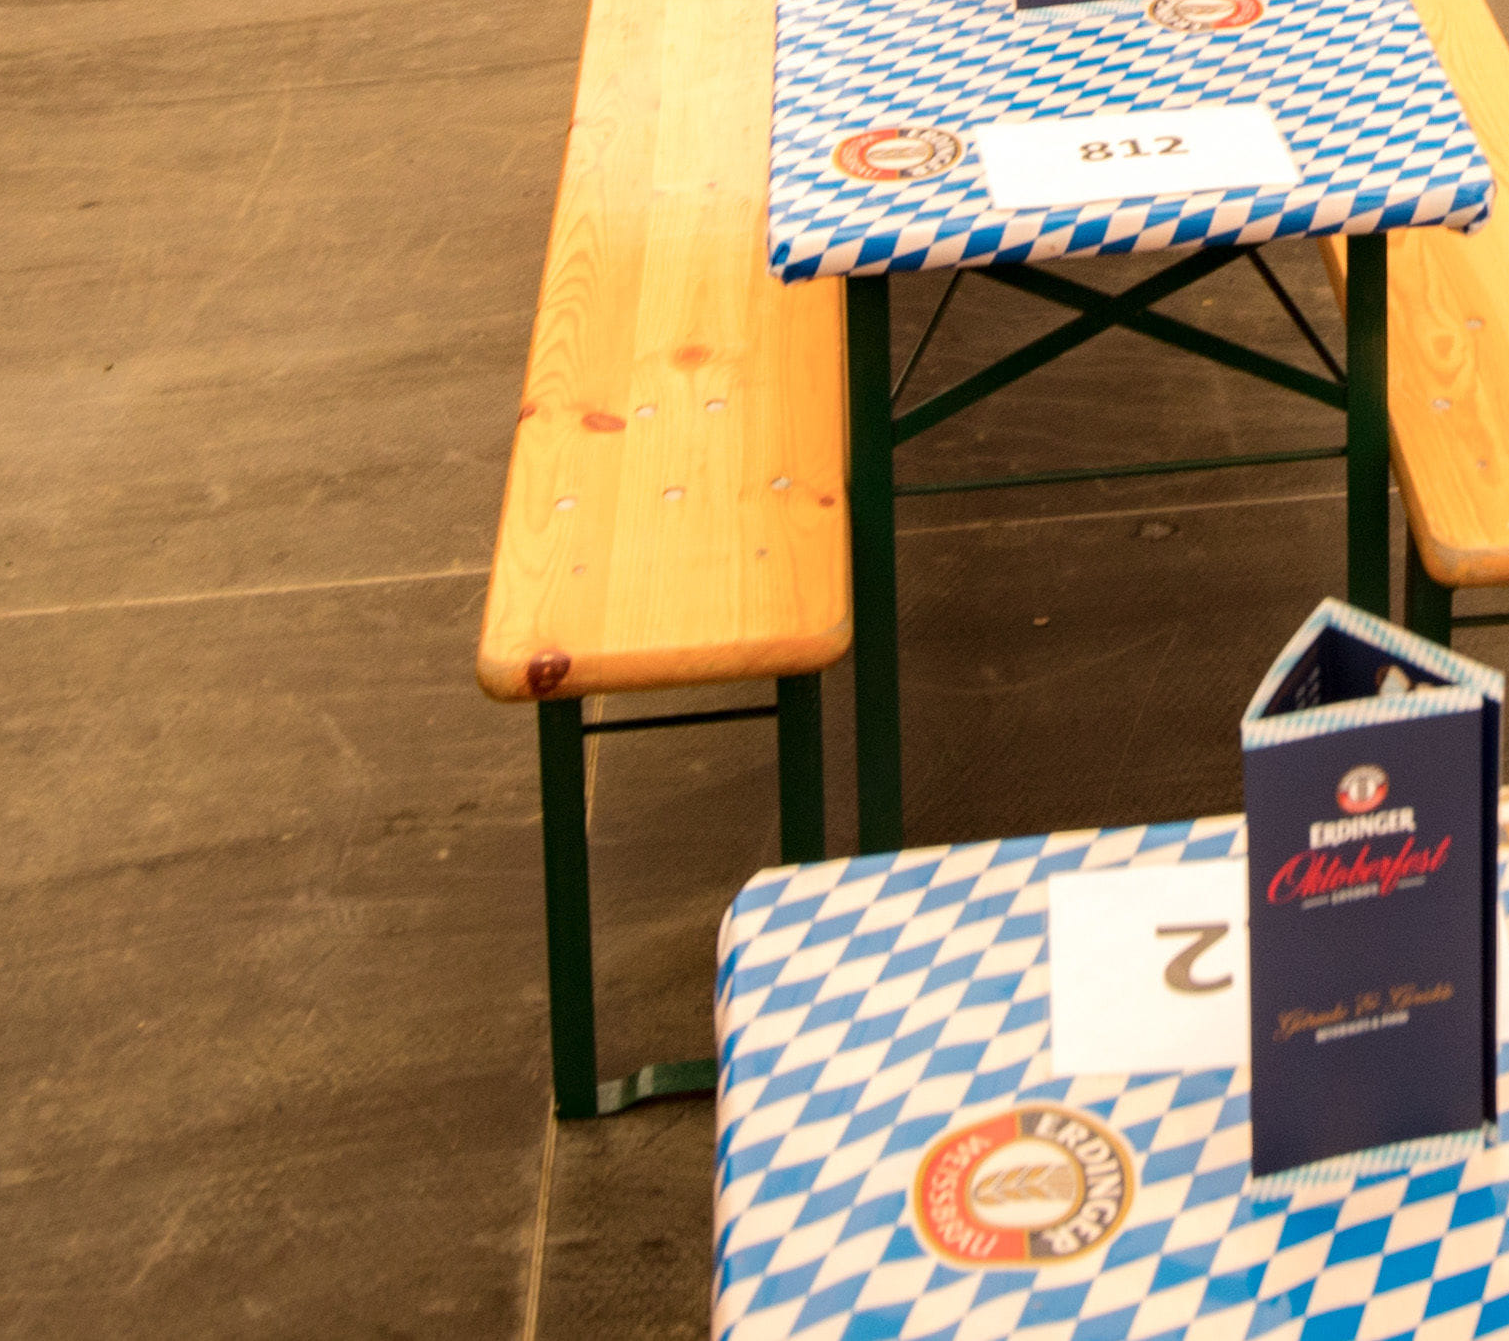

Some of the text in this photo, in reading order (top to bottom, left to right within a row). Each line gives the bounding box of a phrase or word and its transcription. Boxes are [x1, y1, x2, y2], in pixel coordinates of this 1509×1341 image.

[1079, 134, 1189, 162] 812
[1309, 805, 1417, 850] ERDINGER
[1266, 835, 1452, 905] Oktoberfest
[1034, 1112, 1124, 1256] ERDINGER
